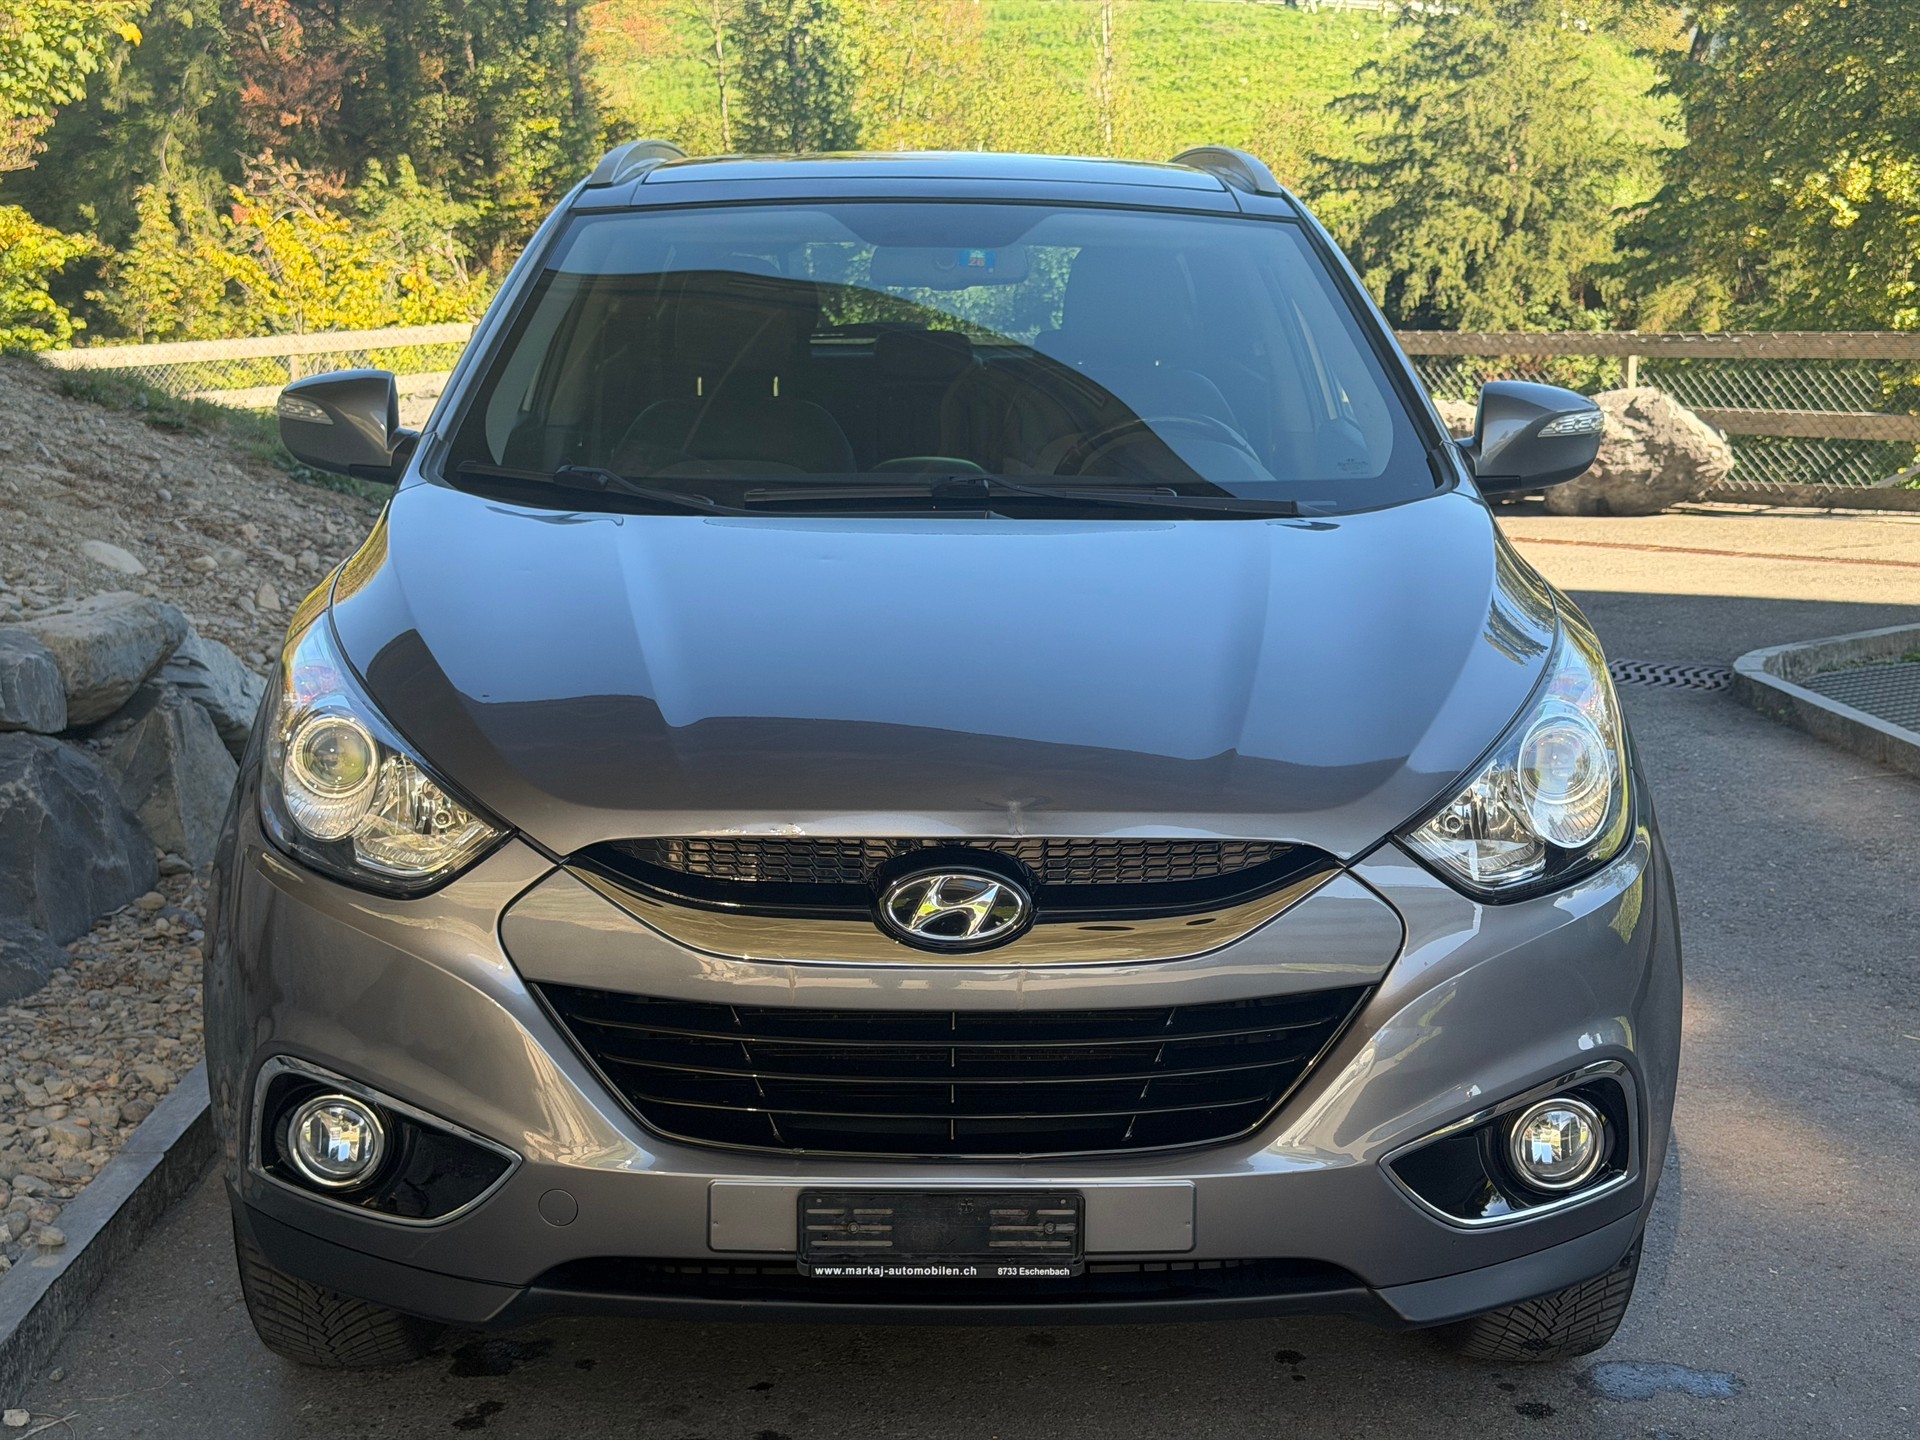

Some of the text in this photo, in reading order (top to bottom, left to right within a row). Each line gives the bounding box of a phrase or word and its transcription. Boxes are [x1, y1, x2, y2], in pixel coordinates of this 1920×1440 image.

[814, 1265, 977, 1277] www.markaj-automobilen.ch
[997, 1267, 1070, 1276] 8733 Eschenbach
